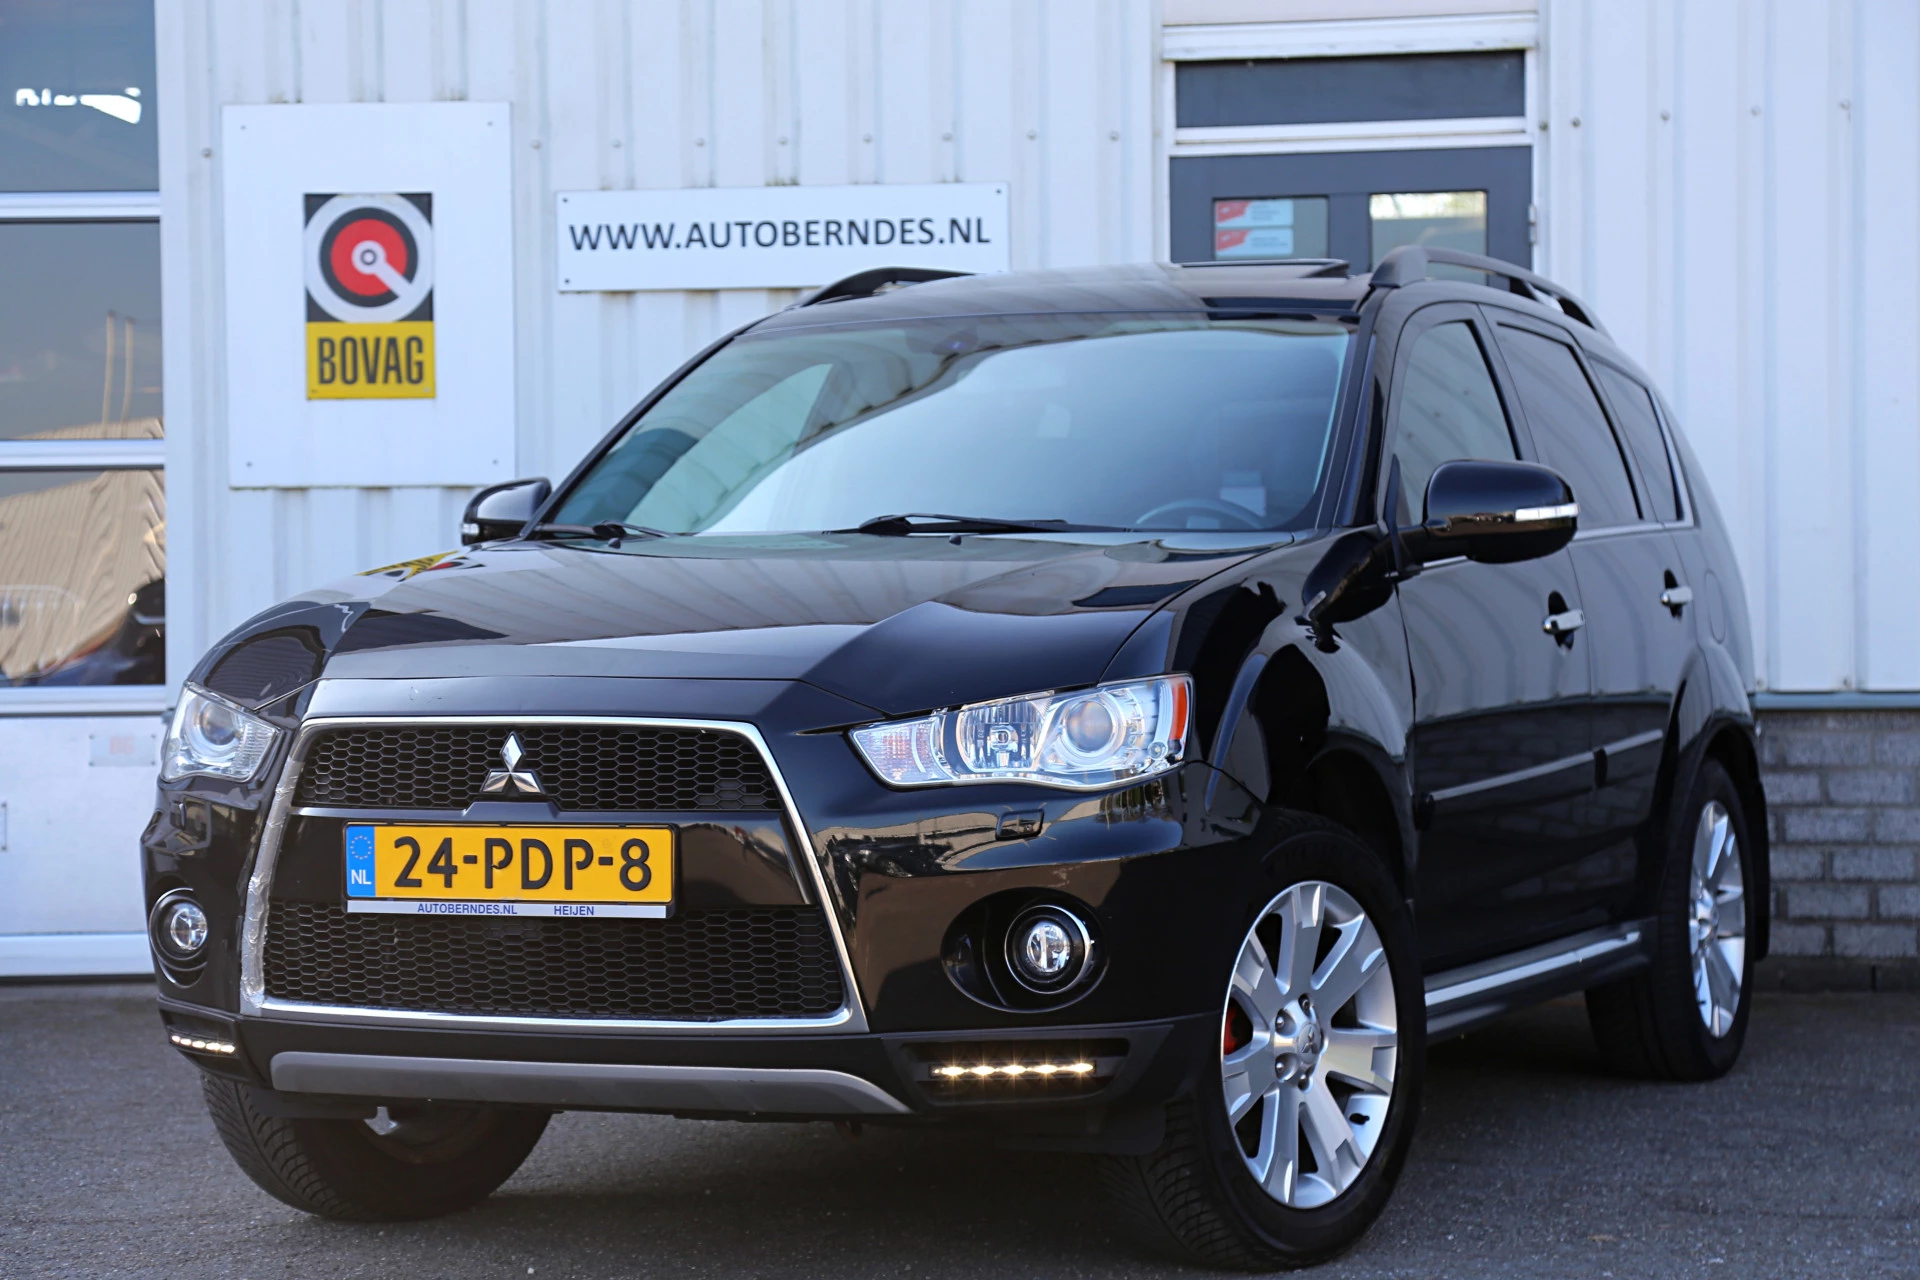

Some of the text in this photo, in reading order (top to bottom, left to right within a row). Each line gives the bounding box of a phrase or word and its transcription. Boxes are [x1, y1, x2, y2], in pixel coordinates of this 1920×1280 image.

[569, 217, 990, 250] WWW.AUTOBERNDES.NL
[317, 336, 424, 385] BOVAG
[351, 869, 372, 885] NL
[394, 836, 652, 891] 24-PDP-8
[417, 903, 594, 916] AUTOBERNDES.NL HEIJEN
